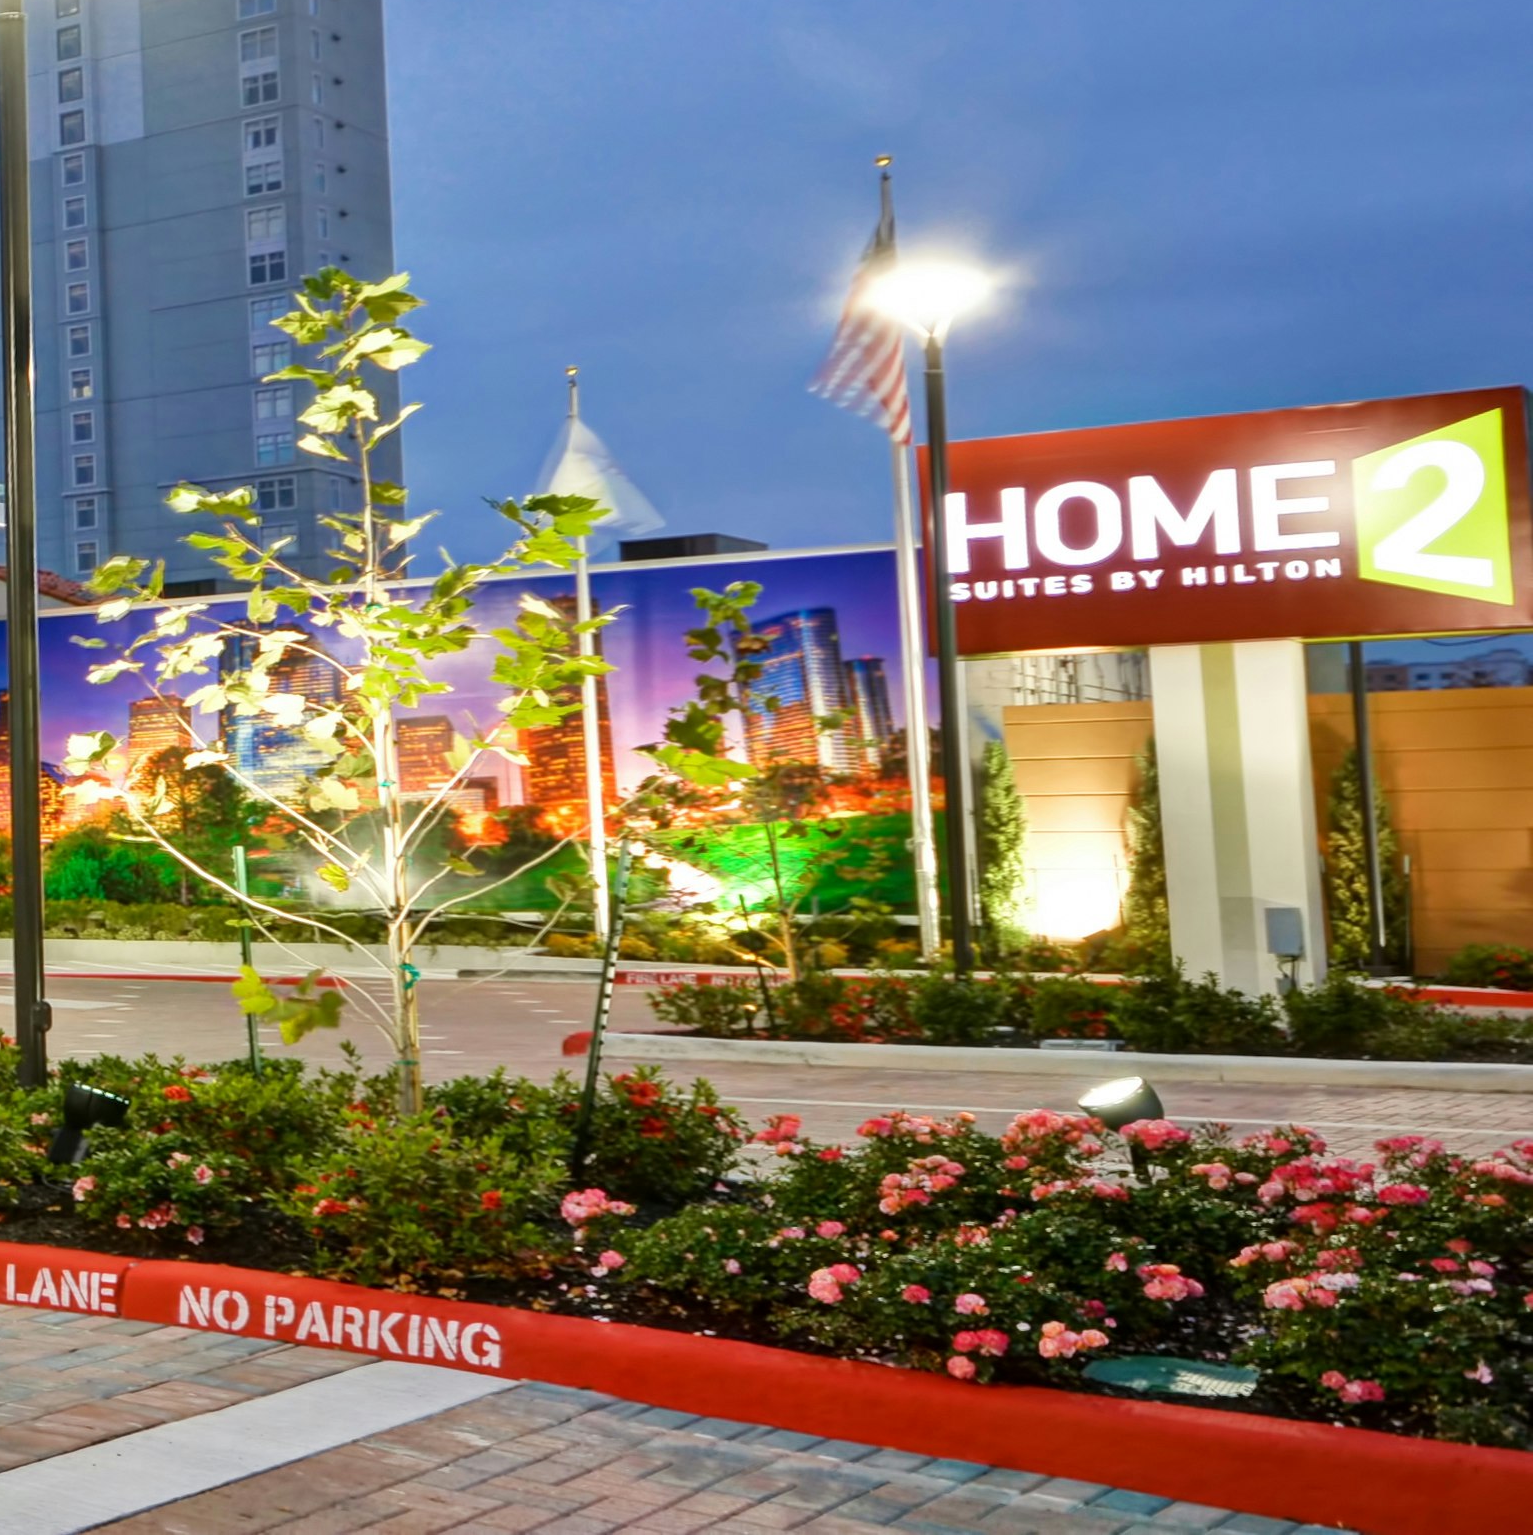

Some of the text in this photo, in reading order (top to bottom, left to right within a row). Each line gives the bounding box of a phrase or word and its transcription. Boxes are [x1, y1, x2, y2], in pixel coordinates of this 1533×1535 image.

[944, 440, 1493, 588] HOME 2
[949, 557, 1342, 602] SUITES BY HILTON
[627, 973, 658, 985] FIRE
[660, 973, 697, 986] LANE
[6, 1263, 118, 1314] LANE
[178, 1284, 250, 1332] NO
[265, 1295, 502, 1369] PARKING
